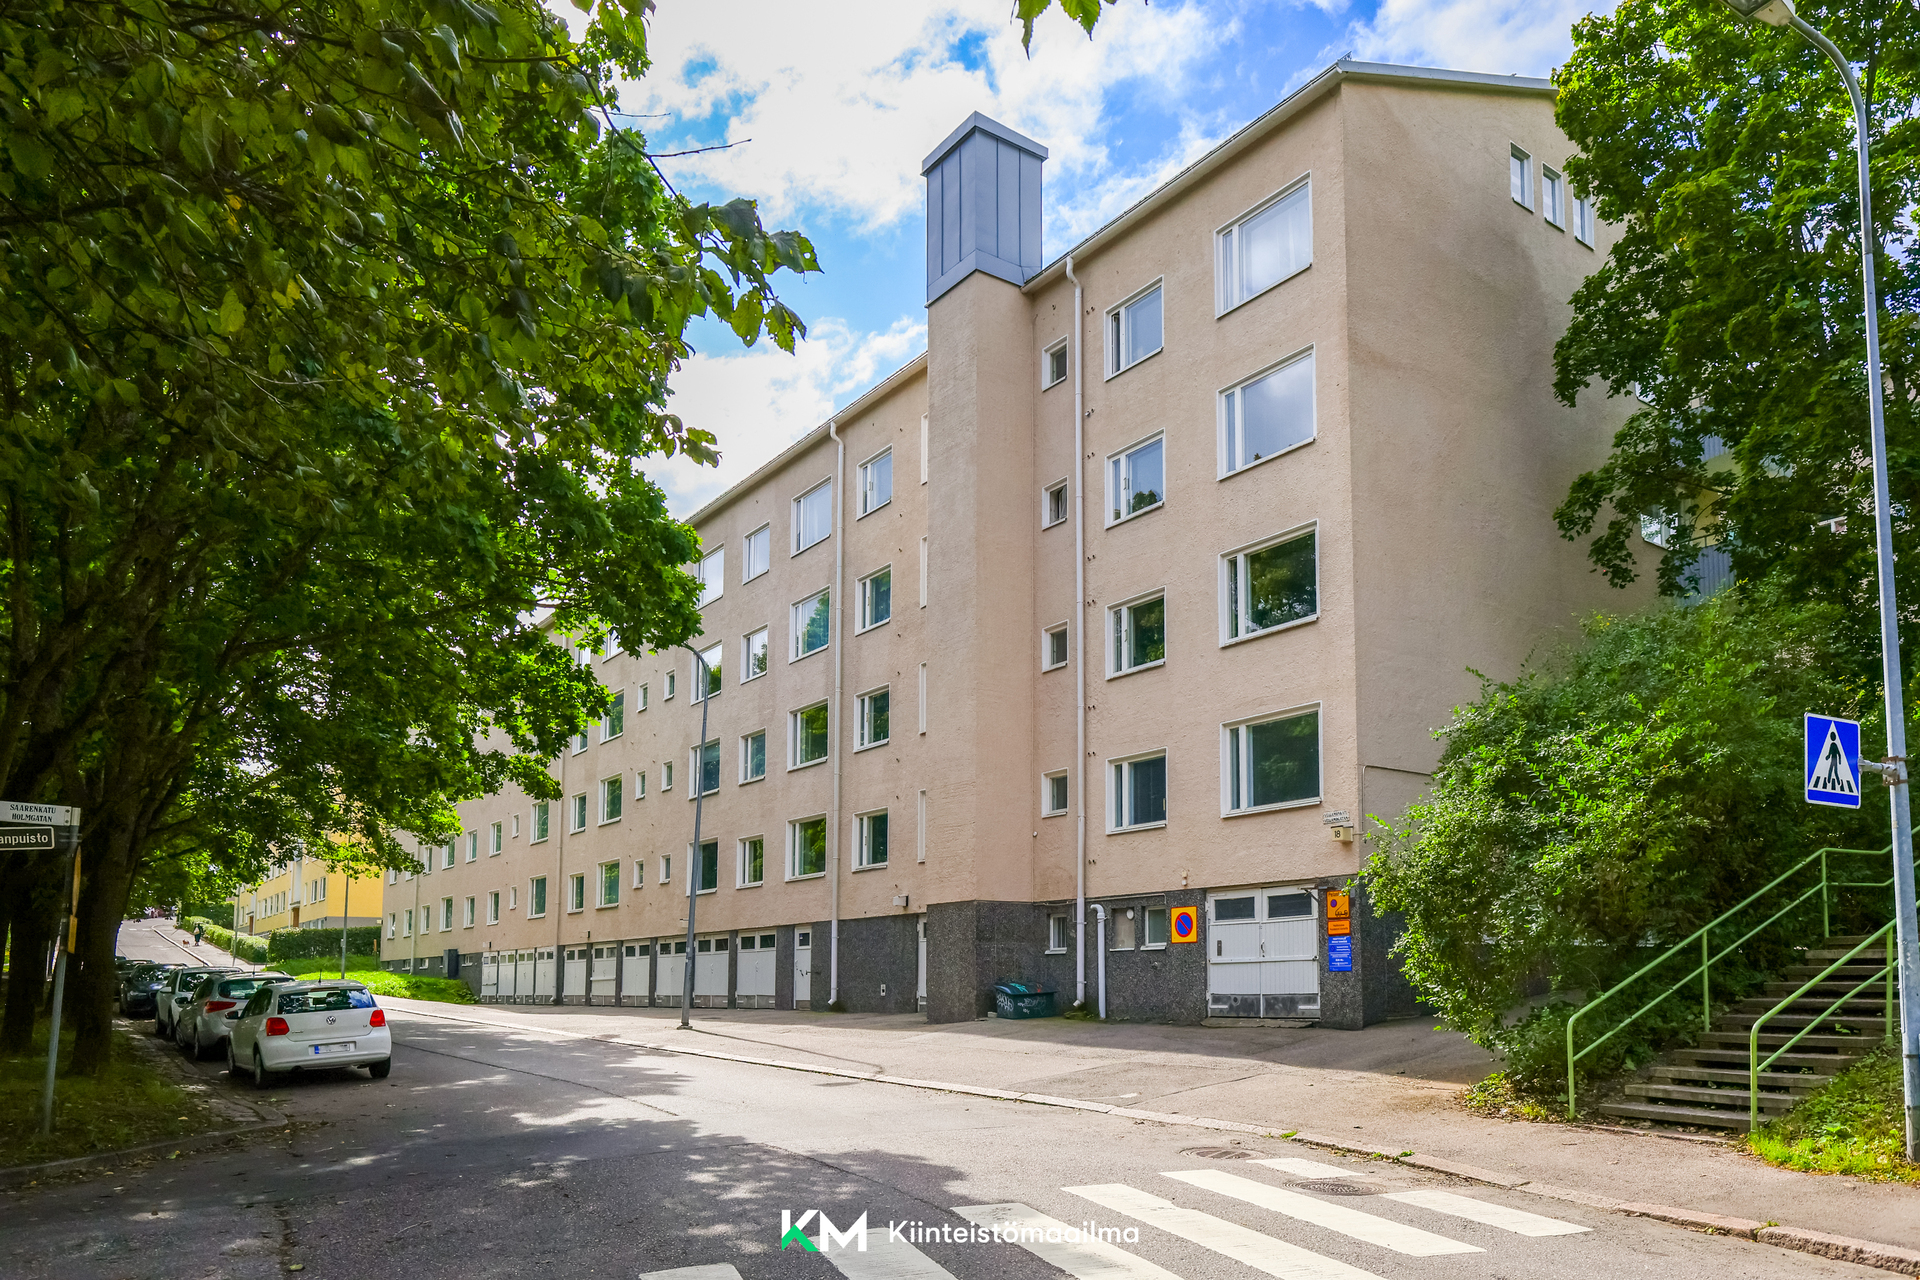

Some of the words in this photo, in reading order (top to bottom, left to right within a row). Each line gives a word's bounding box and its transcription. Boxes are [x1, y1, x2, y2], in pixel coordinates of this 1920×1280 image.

[10, 804, 57, 814] SAARENKATU
[11, 813, 53, 823] HOLMGATAN
[1334, 830, 1341, 838] 18
